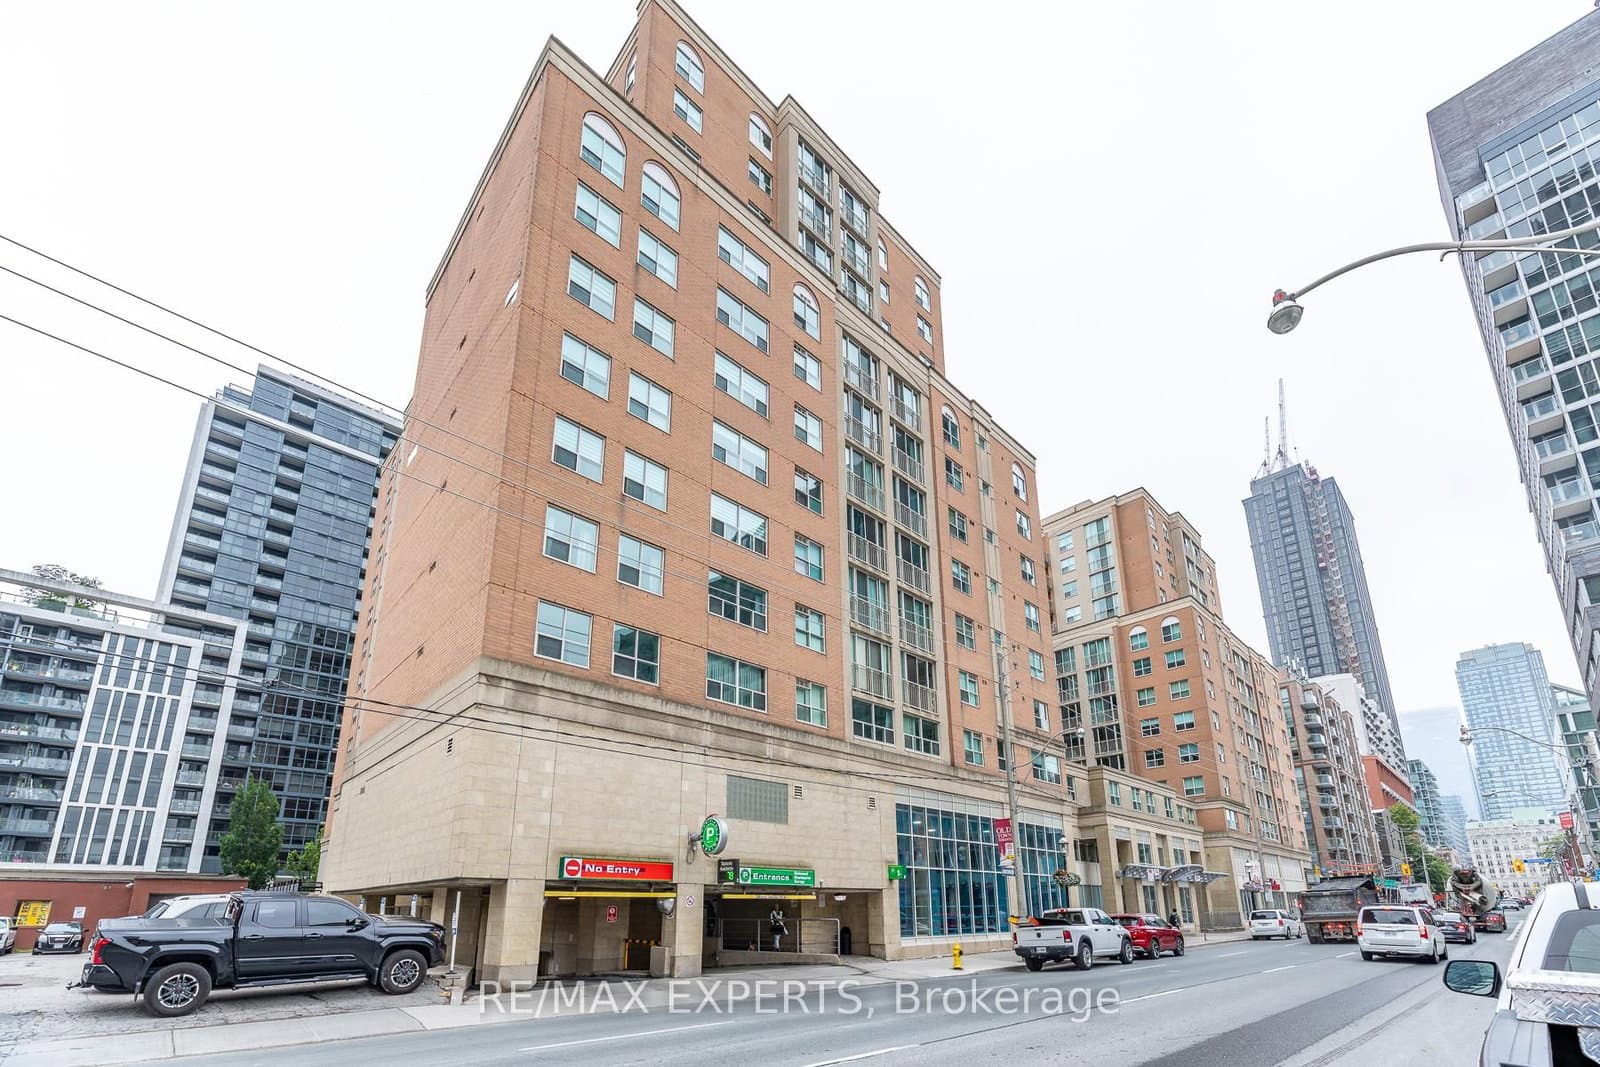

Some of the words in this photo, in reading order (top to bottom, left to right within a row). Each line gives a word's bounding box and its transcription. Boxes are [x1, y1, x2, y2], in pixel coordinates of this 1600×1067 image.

[584, 863, 602, 873] No
[606, 864, 640, 876] Entry
[752, 872, 790, 881] Entrance
